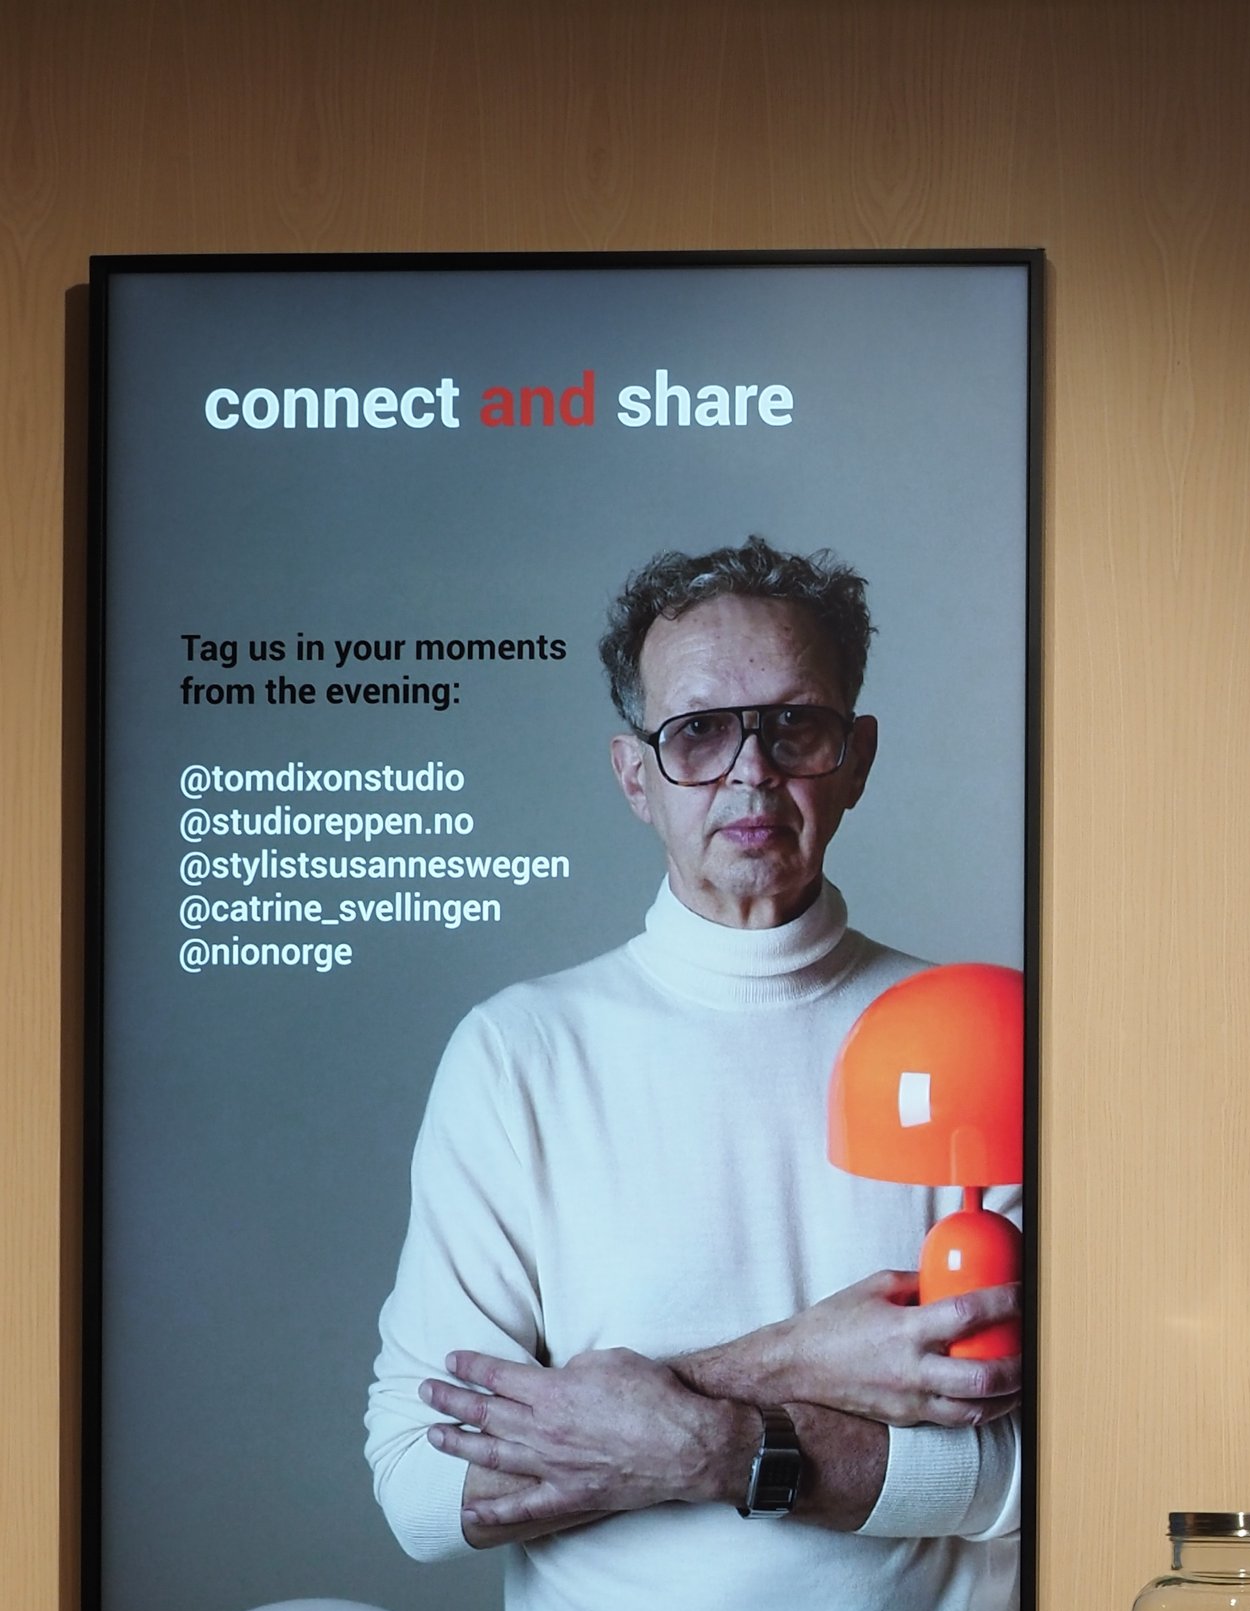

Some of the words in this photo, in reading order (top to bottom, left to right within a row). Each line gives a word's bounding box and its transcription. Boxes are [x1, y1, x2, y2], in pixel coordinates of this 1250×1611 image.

[204, 377, 461, 430] connect
[480, 369, 596, 427] and
[617, 368, 794, 428] share
[180, 634, 238, 669] Tag
[249, 640, 286, 662] us
[296, 631, 325, 661] in
[334, 639, 406, 669] your
[415, 634, 567, 662] moments
[179, 675, 255, 705] from
[264, 675, 316, 705] the
[326, 674, 460, 712] evening:
[180, 761, 465, 800] @tomdixonstudio
[180, 805, 474, 843] @studioreppen.no
[179, 848, 570, 887] @stylistsusanneswegen
[179, 892, 501, 930] @catrine_svellingen
[179, 935, 353, 973] @nionorge
